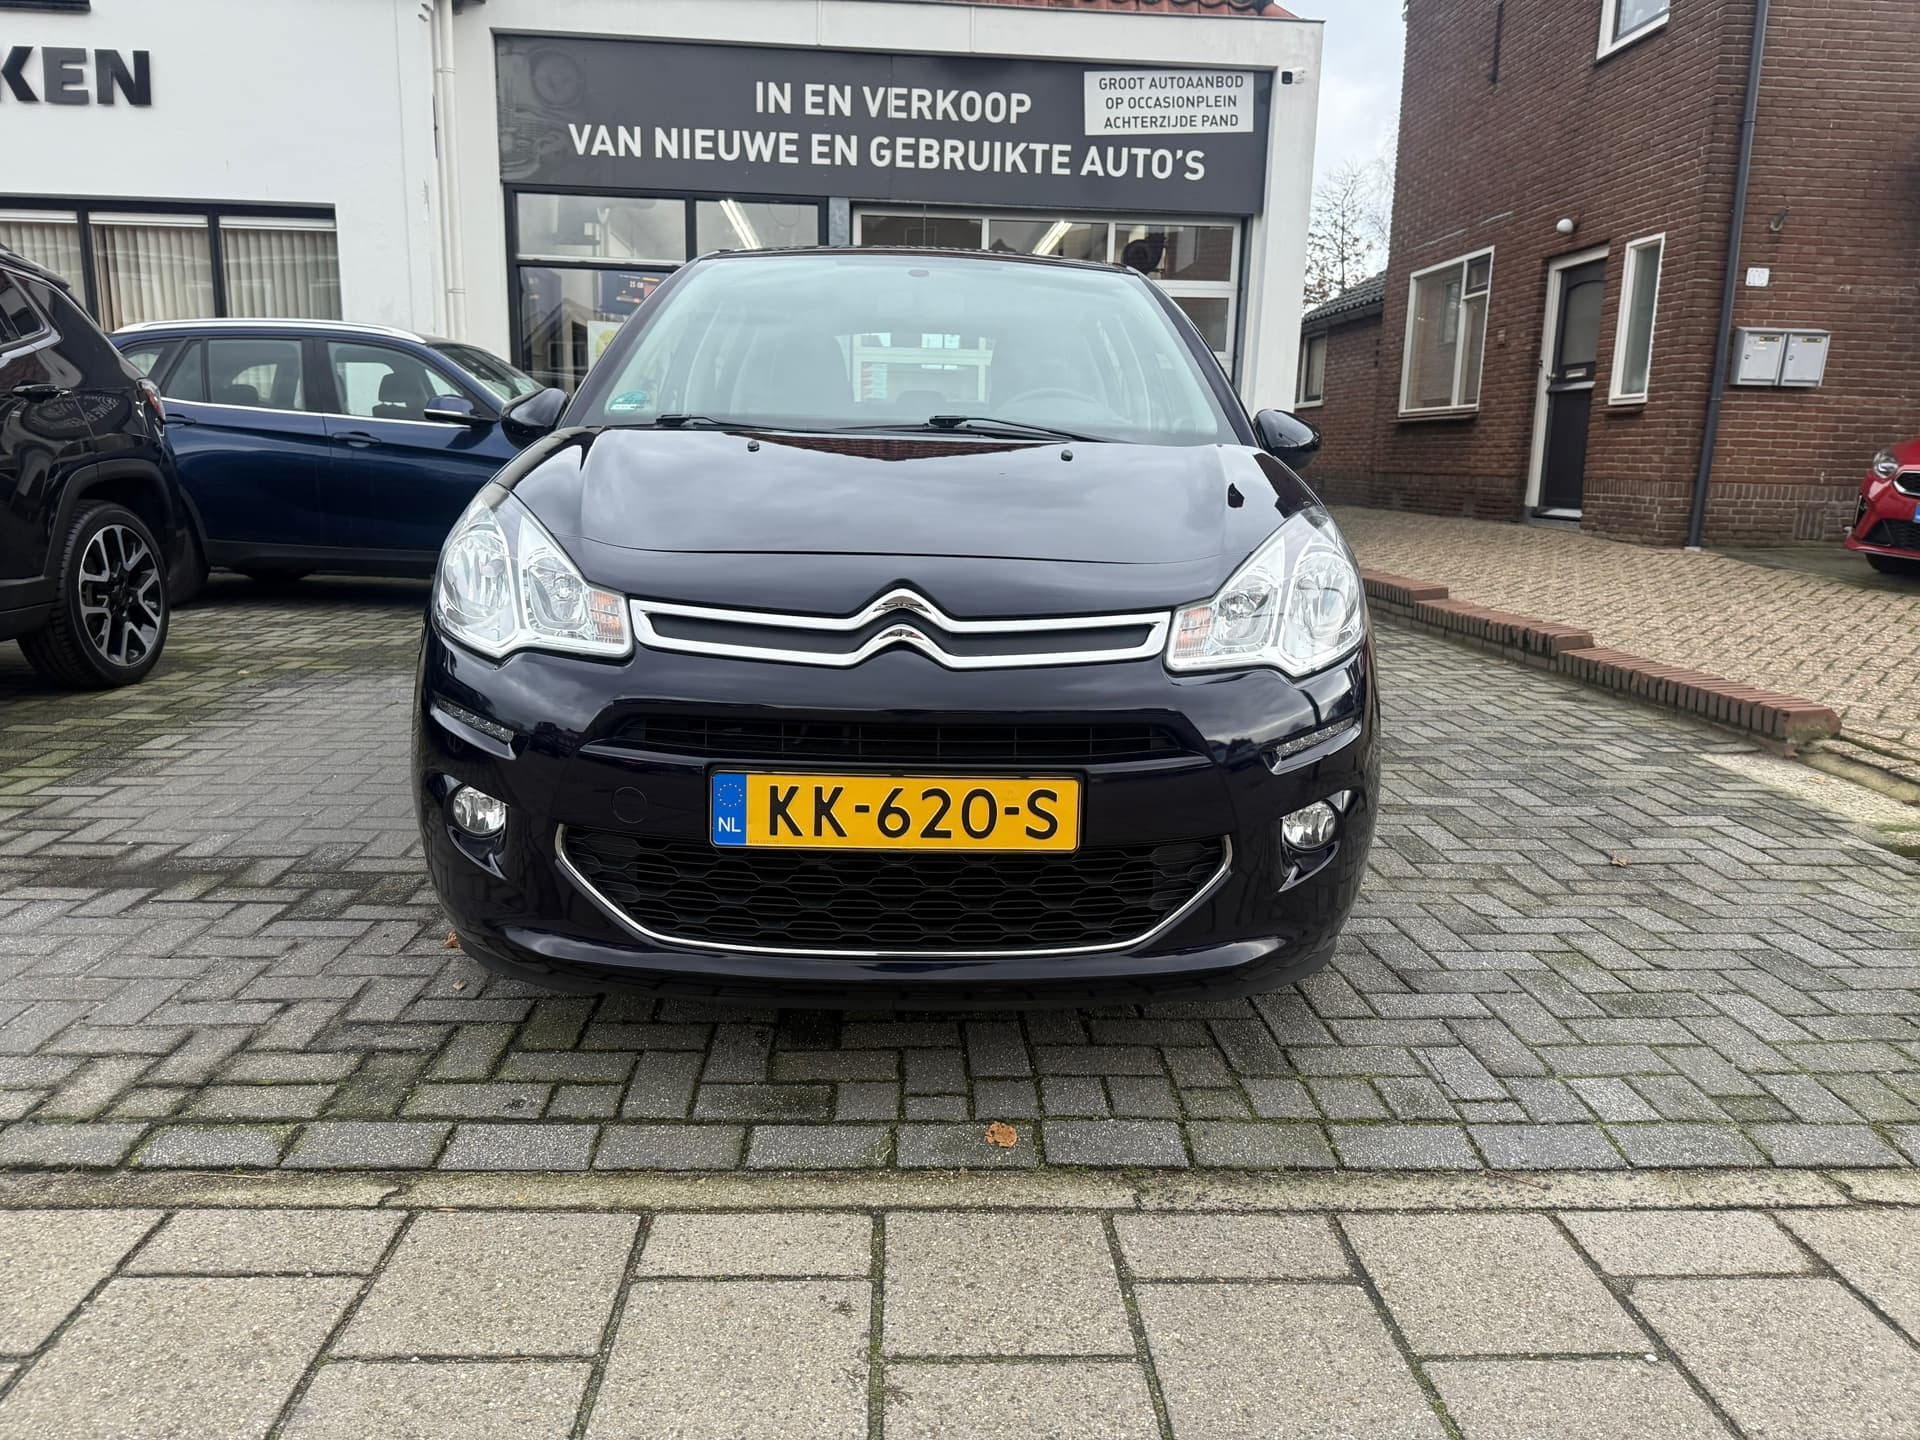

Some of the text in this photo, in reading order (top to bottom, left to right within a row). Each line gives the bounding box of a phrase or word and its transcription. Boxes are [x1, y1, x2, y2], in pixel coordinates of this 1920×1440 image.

[1099, 75, 1244, 90] GROOT AUTOAANBOD
[755, 81, 1032, 124] IN EN VERKOOP
[1105, 95, 1237, 110] OP OCCASIONPLEIN
[1104, 114, 1239, 129] ACHTERZIJDE PAND
[568, 123, 1206, 181] VAN NIEUWE EN GEBRUIKTE AUTO'S
[769, 785, 1059, 840] KK-620-S
[718, 816, 742, 833] NL
